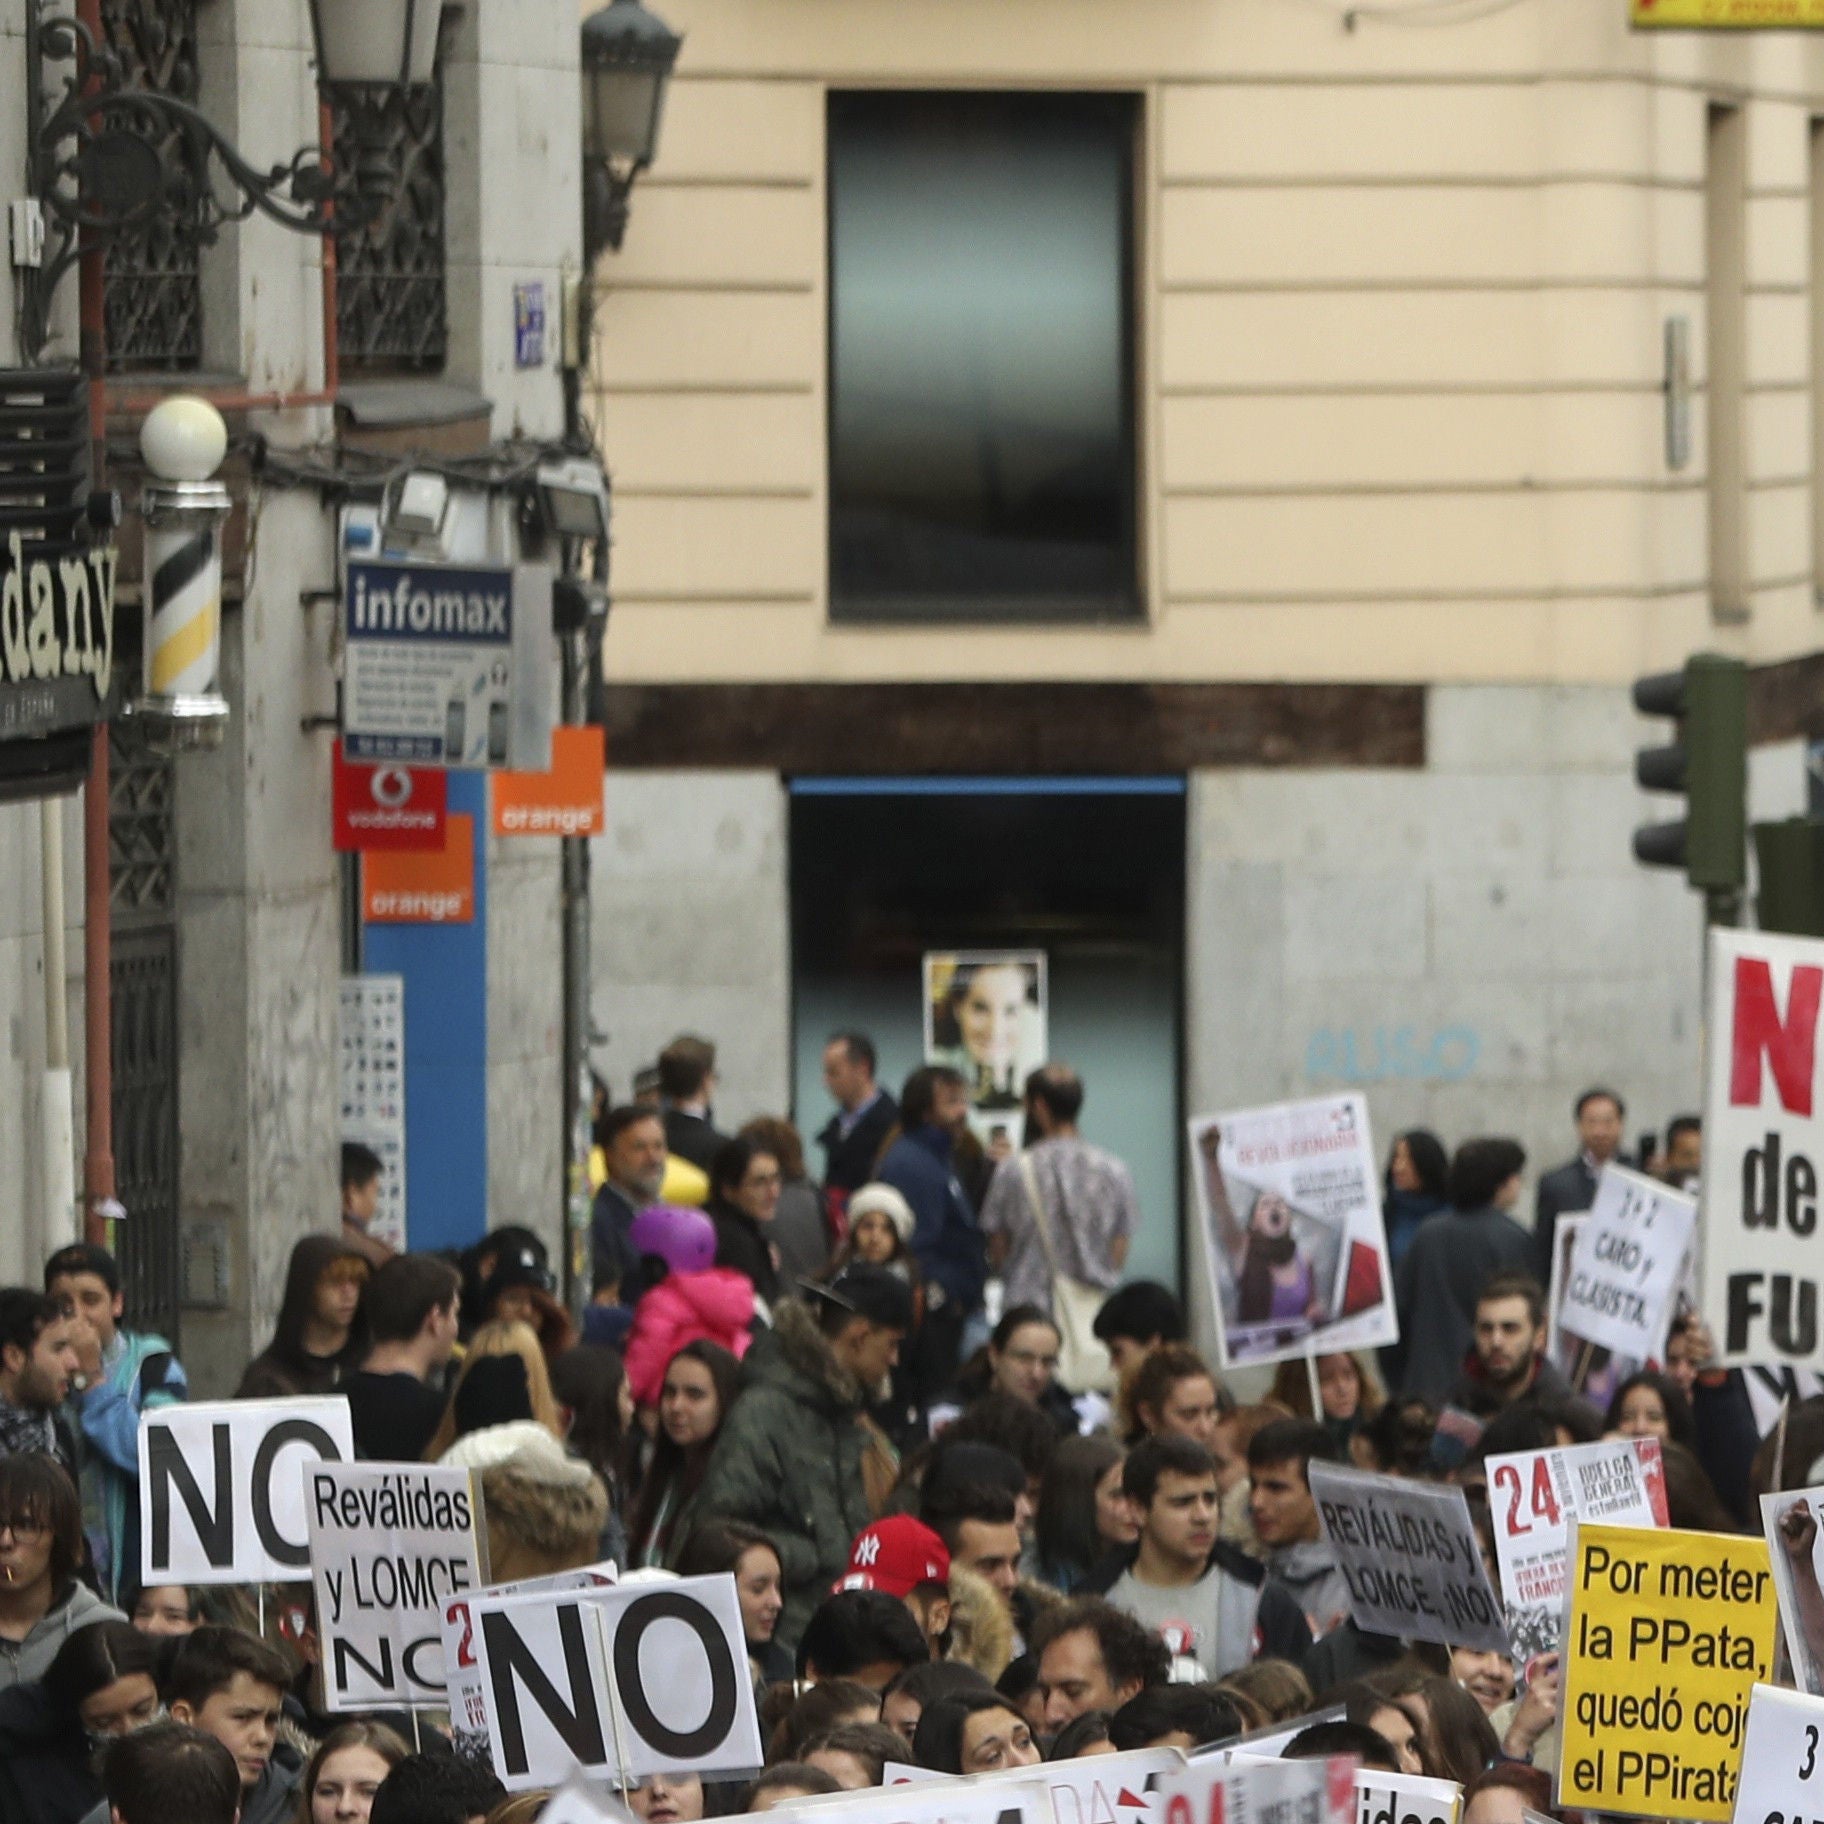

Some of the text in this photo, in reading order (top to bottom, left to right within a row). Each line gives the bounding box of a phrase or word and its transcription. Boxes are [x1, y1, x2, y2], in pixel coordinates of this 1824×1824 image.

[0, 528, 117, 698] dany
[355, 576, 507, 634] infomax
[348, 808, 436, 831] vodafone
[502, 806, 592, 833] orange
[371, 892, 462, 918] orange
[1741, 1131, 1818, 1239] de
[1593, 1233, 1641, 1275] CARO
[311, 1473, 473, 1534] Reválidas
[1494, 1454, 1562, 1538] 24
[1322, 1495, 1479, 1571] REVÁLIDAS y
[1582, 1544, 1771, 1605] Por meter
[1579, 1612, 1768, 1676] la PPata,
[481, 1591, 738, 1775] NO
